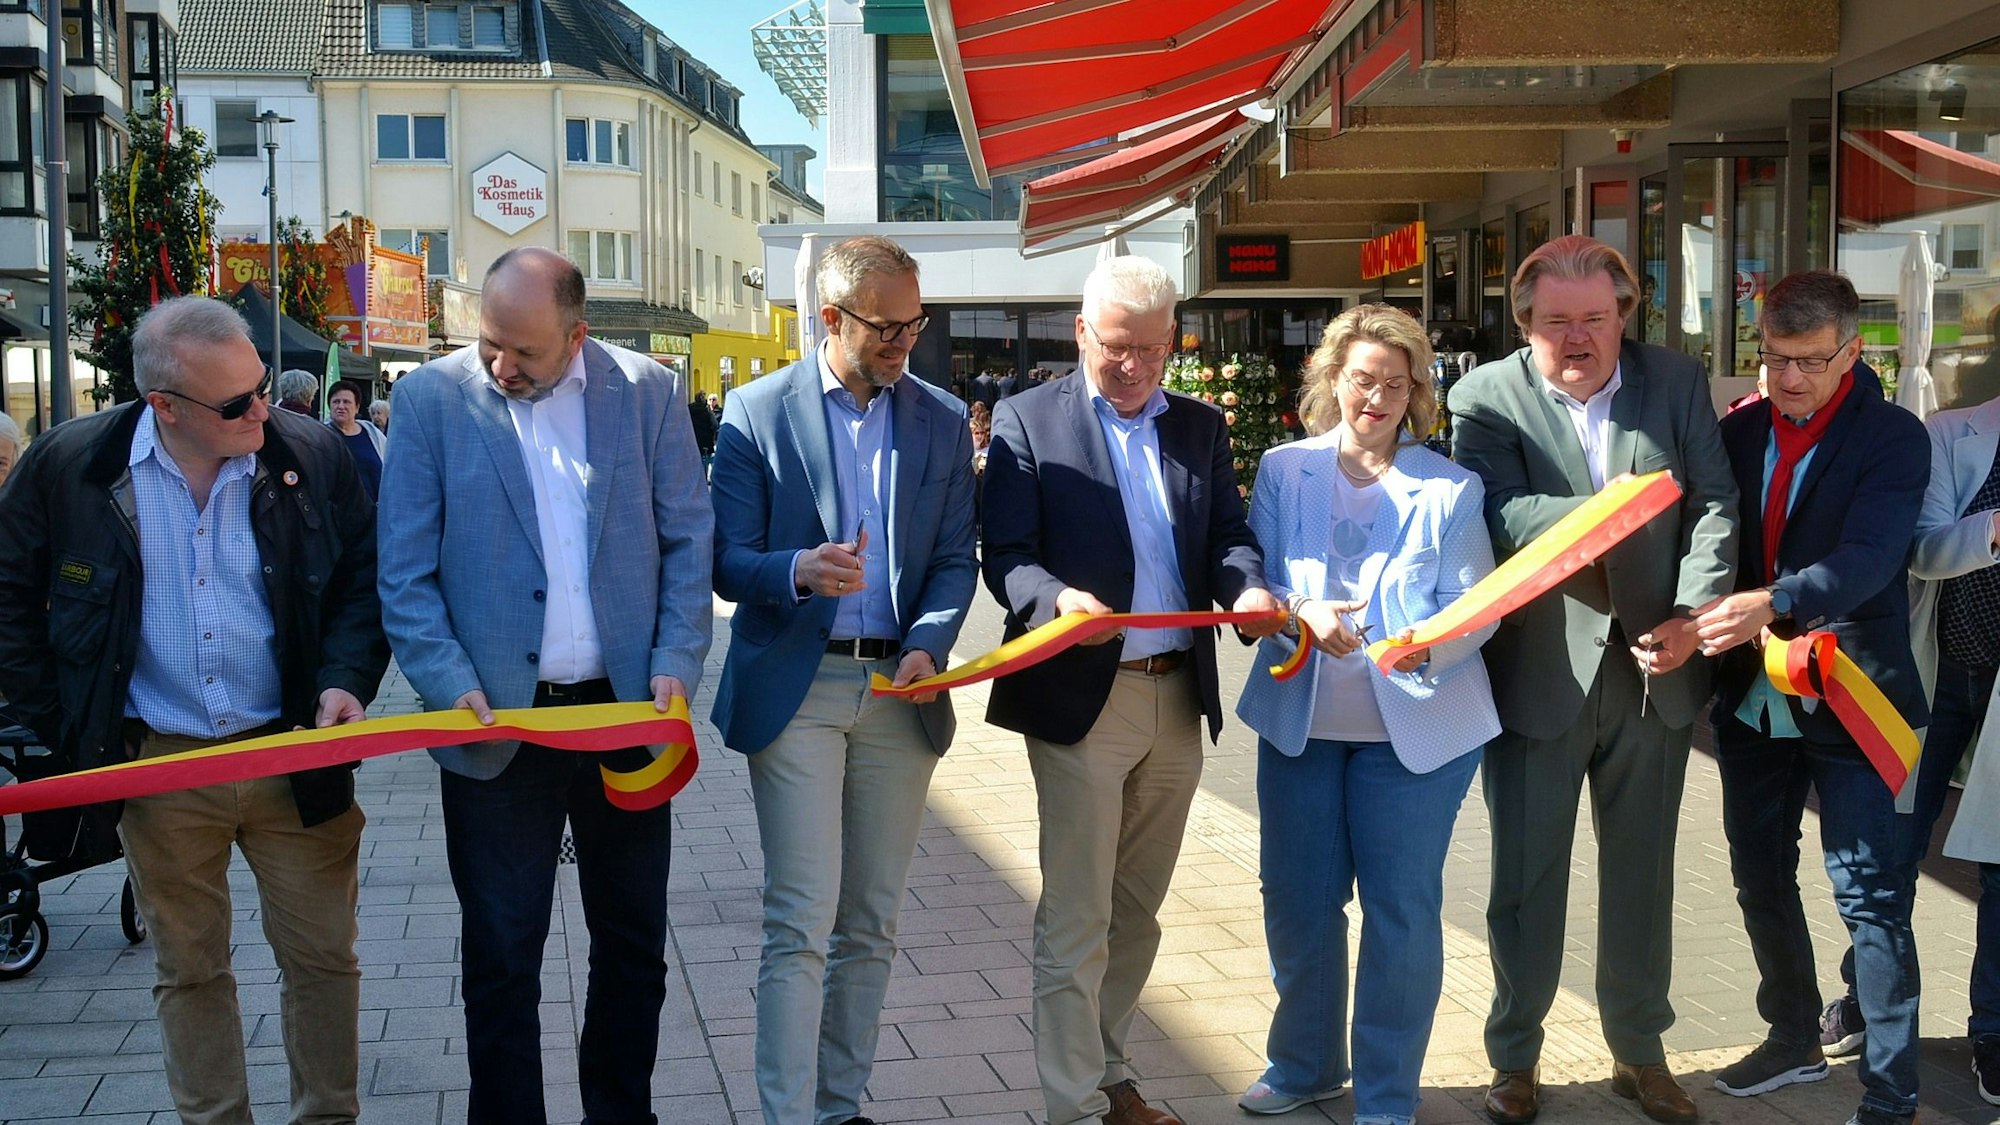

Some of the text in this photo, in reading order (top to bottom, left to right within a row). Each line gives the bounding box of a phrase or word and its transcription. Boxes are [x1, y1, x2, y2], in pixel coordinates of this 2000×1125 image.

[487, 175, 517, 189] Das
[477, 186, 544, 201] Kosmetik
[497, 202, 535, 218] Haus
